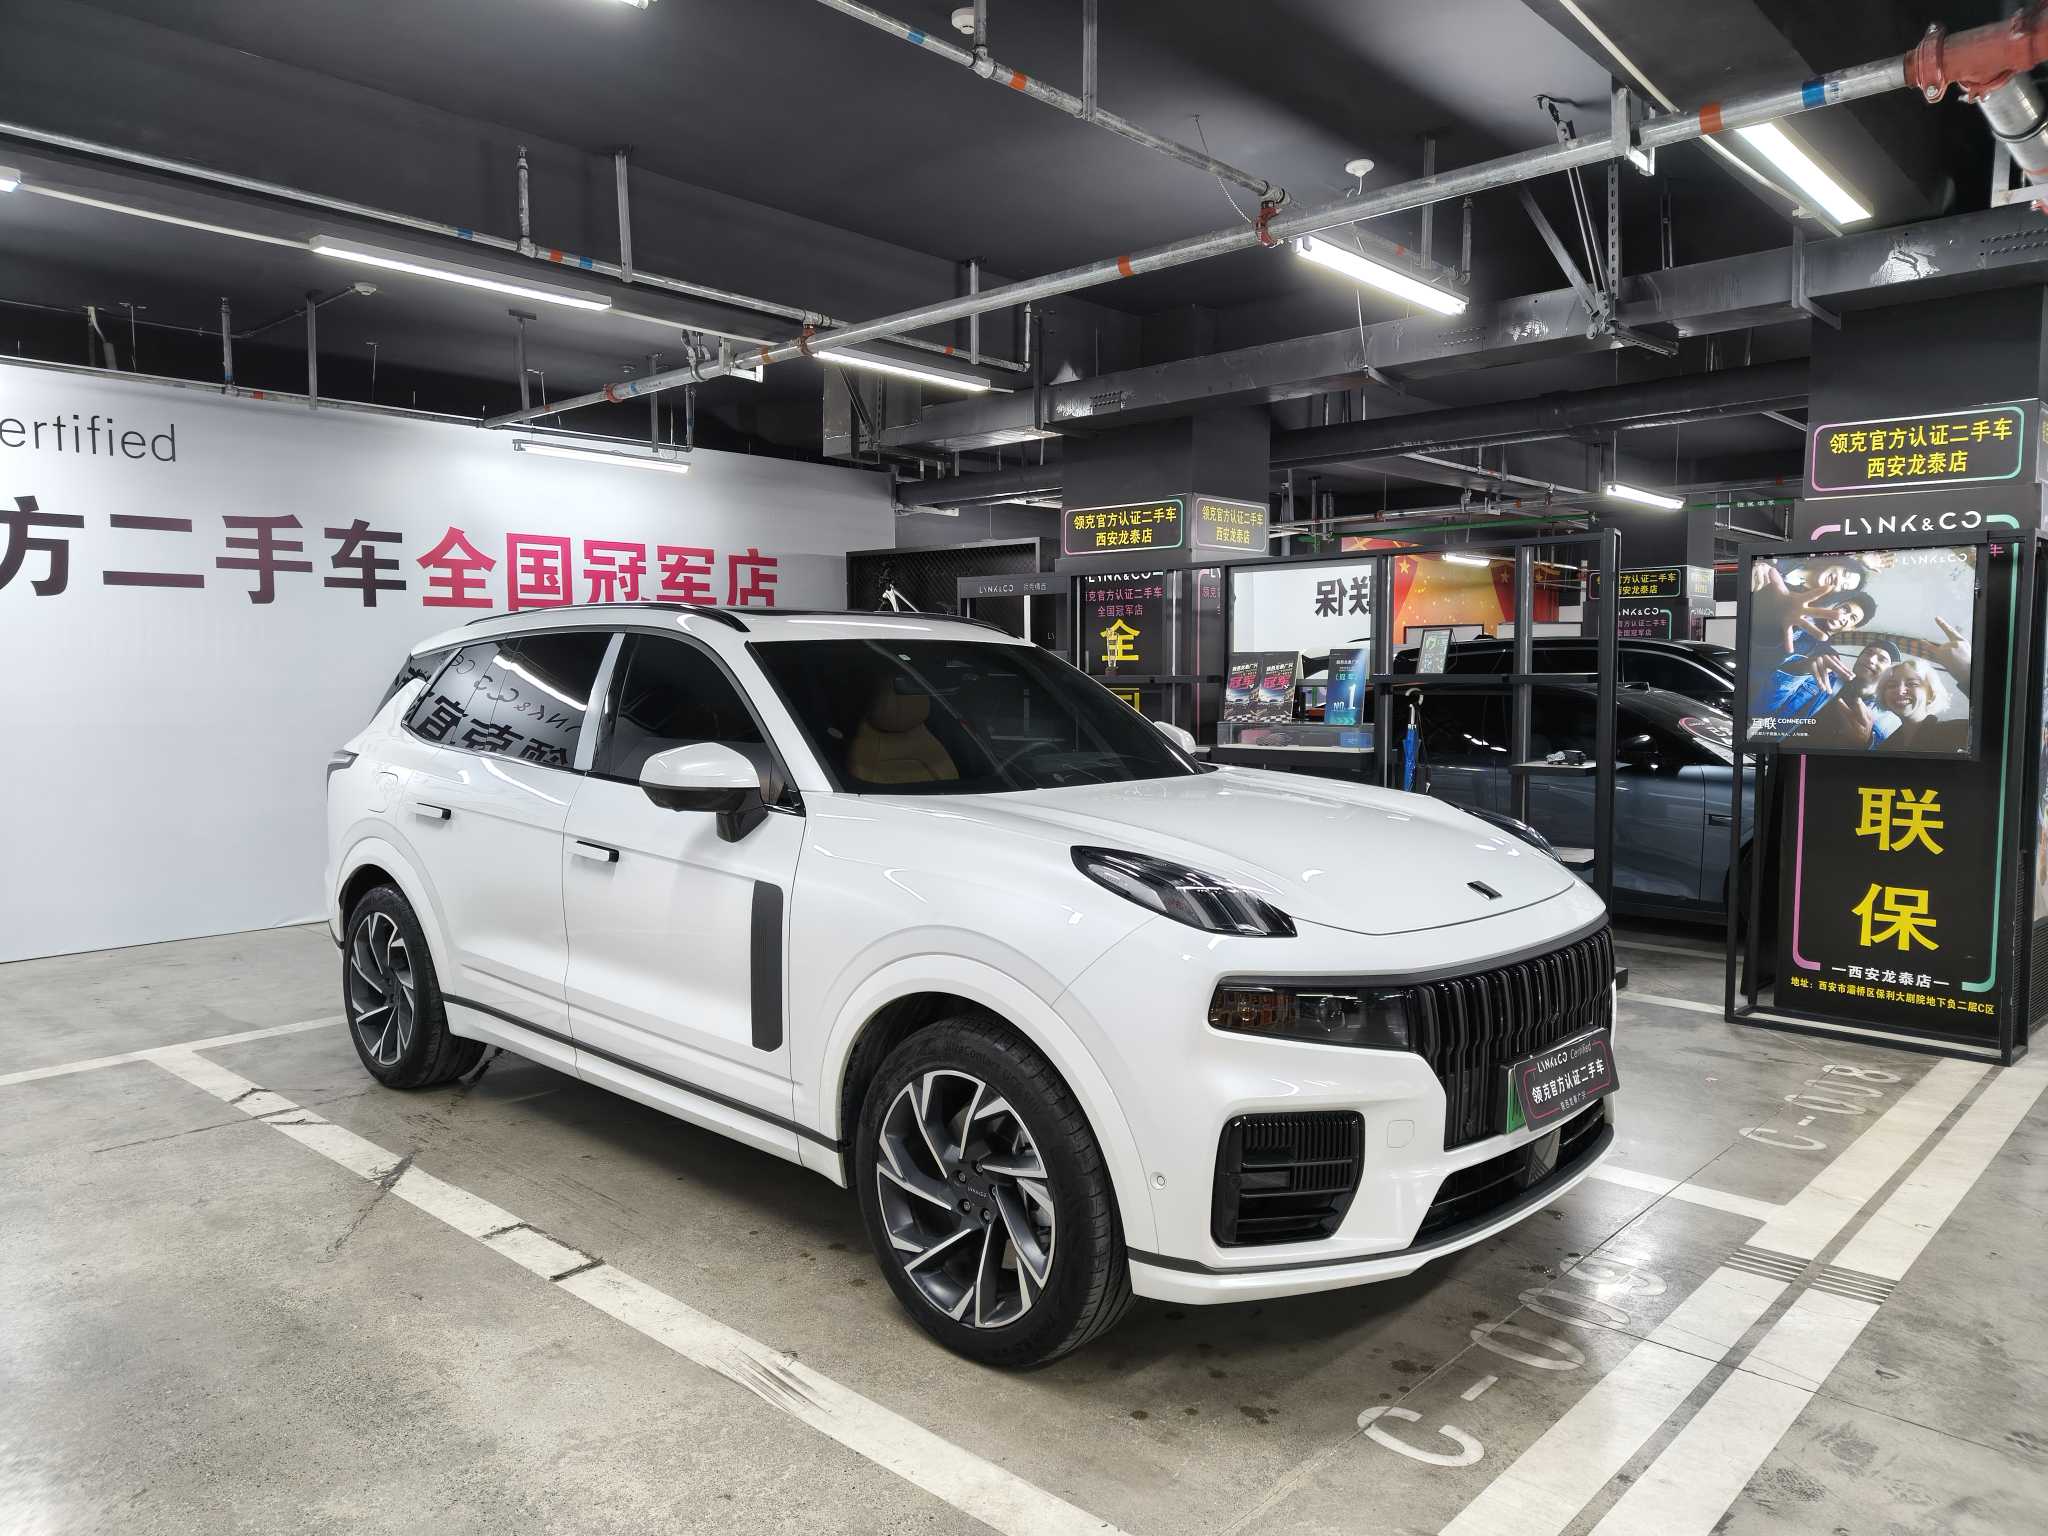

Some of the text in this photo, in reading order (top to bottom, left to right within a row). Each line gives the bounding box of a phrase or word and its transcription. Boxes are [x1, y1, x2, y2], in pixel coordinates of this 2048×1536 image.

[0, 414, 176, 462] ertified
[1829, 417, 2014, 455] 领克官方认证二手车
[1867, 450, 1969, 480] 西安龙泰店
[1073, 506, 1178, 530] 领克官方认证二手车
[1202, 505, 1264, 527] 领克官方认证二手车
[1843, 510, 1982, 536] LYNK&CO
[1095, 527, 1153, 547] 西安龙泰店
[1215, 526, 1250, 545] 西安龙泰店
[1086, 585, 1164, 602] 克官方认证二手车
[1097, 603, 1144, 618] 全国冠军店
[1850, 787, 1945, 953] 联保
[1531, 1058, 1606, 1105] 领克官方认证二手车
